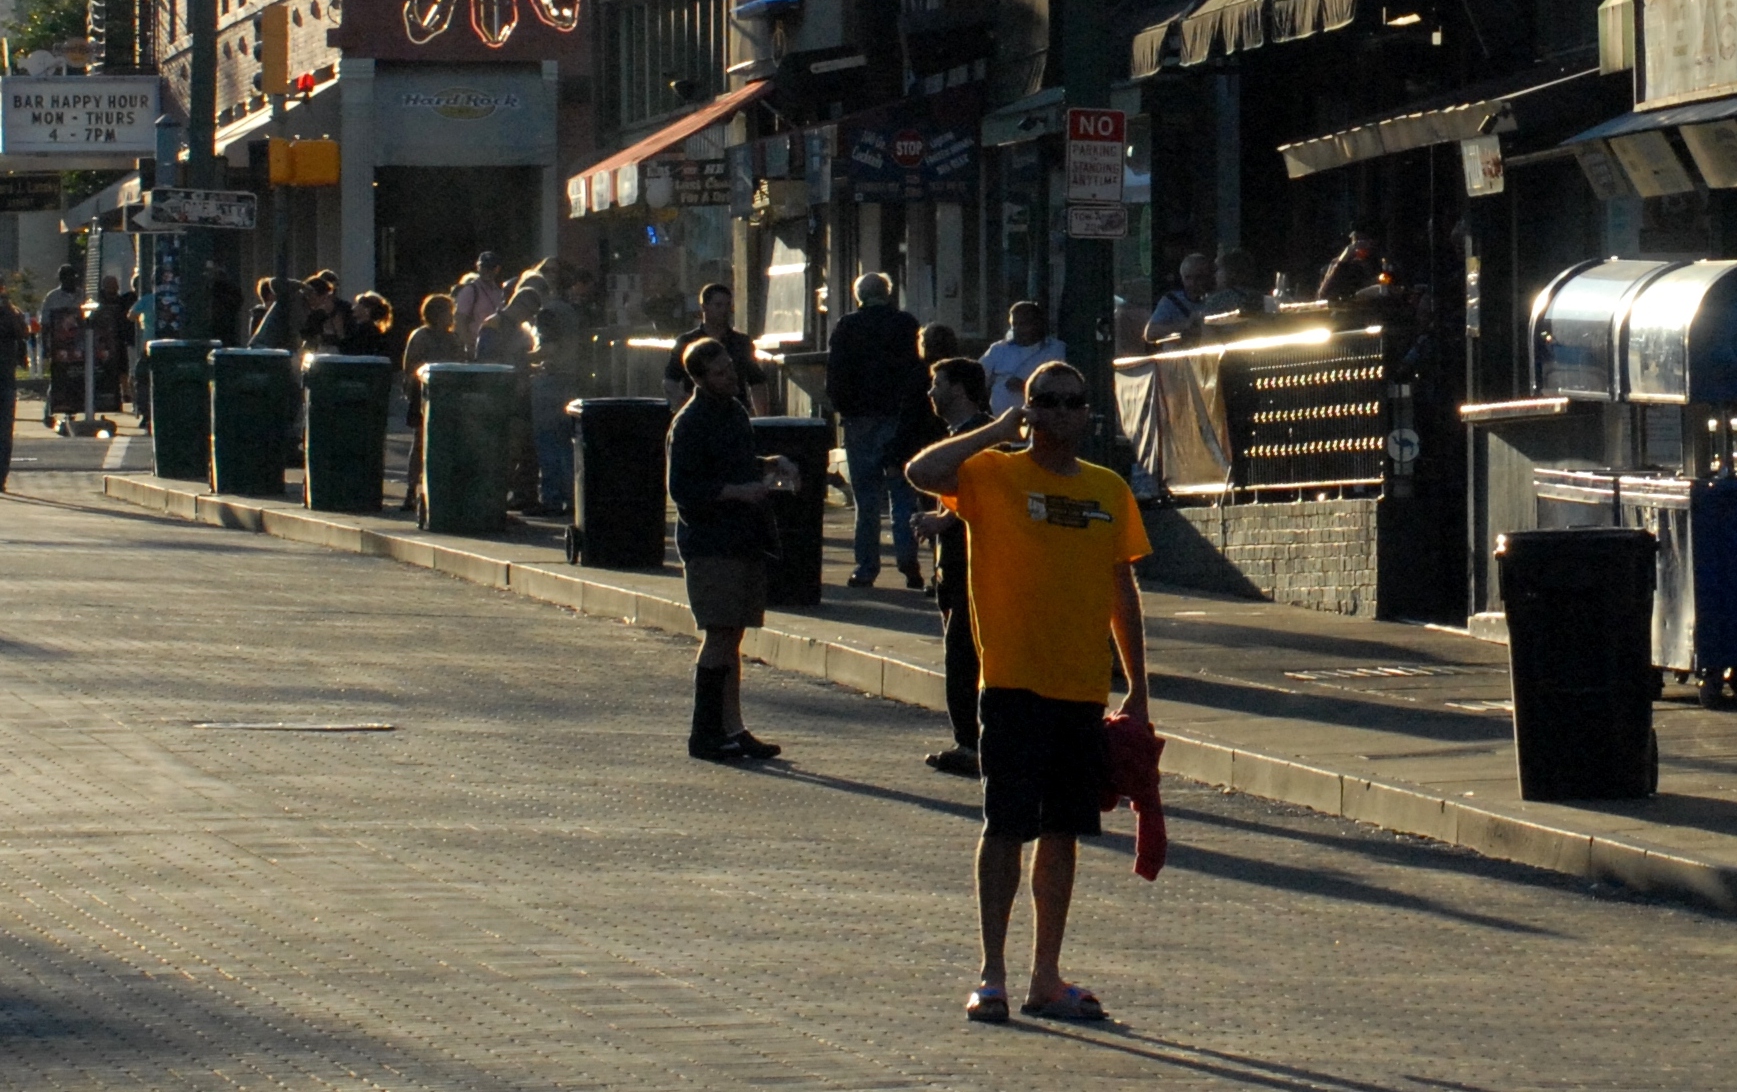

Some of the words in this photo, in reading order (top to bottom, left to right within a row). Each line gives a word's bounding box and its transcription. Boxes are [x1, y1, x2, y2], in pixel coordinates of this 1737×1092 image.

[13, 94, 45, 109] BAR
[47, 94, 103, 109] HAPPY
[107, 94, 150, 109] HOUR
[402, 92, 460, 107] Hard
[466, 93, 520, 108] Rock
[31, 111, 66, 125] MON
[84, 111, 136, 125] THURS
[1079, 115, 1114, 137] NO
[48, 127, 58, 140] 4
[84, 127, 117, 142] 7PM
[895, 140, 923, 156] STOP
[1072, 144, 1118, 157] PARKING
[1071, 161, 1120, 174] STANDING
[1071, 173, 1118, 186] ANYTIME
